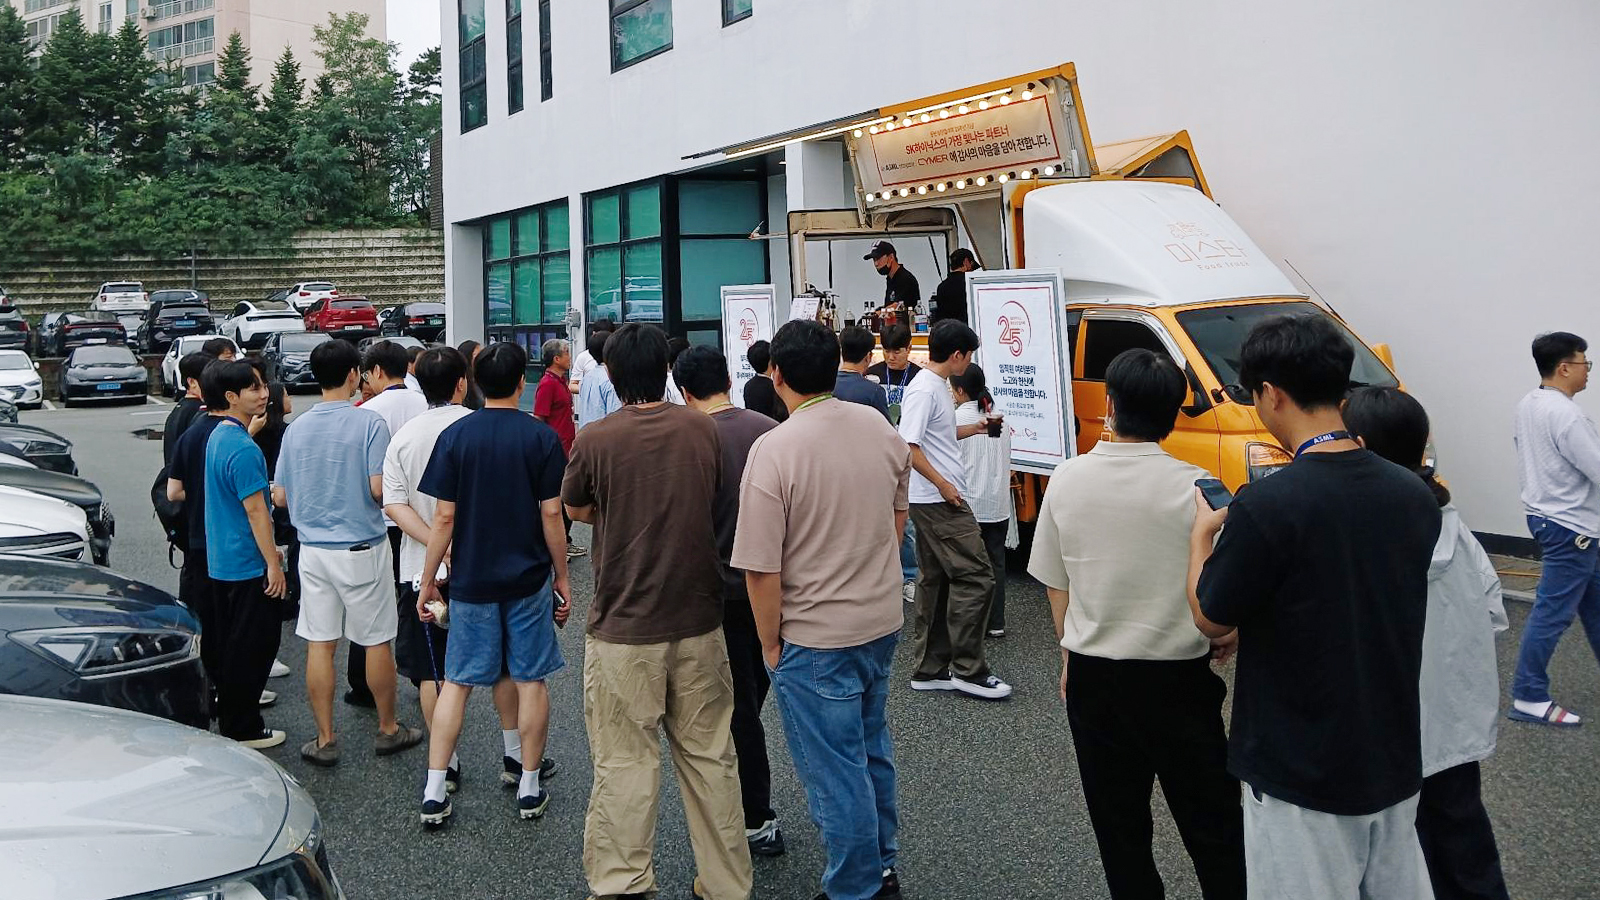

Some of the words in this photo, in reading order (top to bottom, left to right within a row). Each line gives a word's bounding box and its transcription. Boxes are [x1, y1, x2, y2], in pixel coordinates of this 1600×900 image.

[906, 137, 948, 155] SK하이닉스의
[949, 134, 962, 147] 가장
[963, 130, 985, 145] 빛나는
[986, 124, 1010, 140] 파트너
[917, 154, 948, 166] CYMER
[957, 145, 979, 162] 감사의
[978, 142, 1000, 158] 마음을
[1000, 139, 1017, 154] 담아
[1017, 132, 1051, 152] 전합니다.
[1024, 389, 1048, 400] 전합니다.
[1313, 433, 1335, 445] ASML
